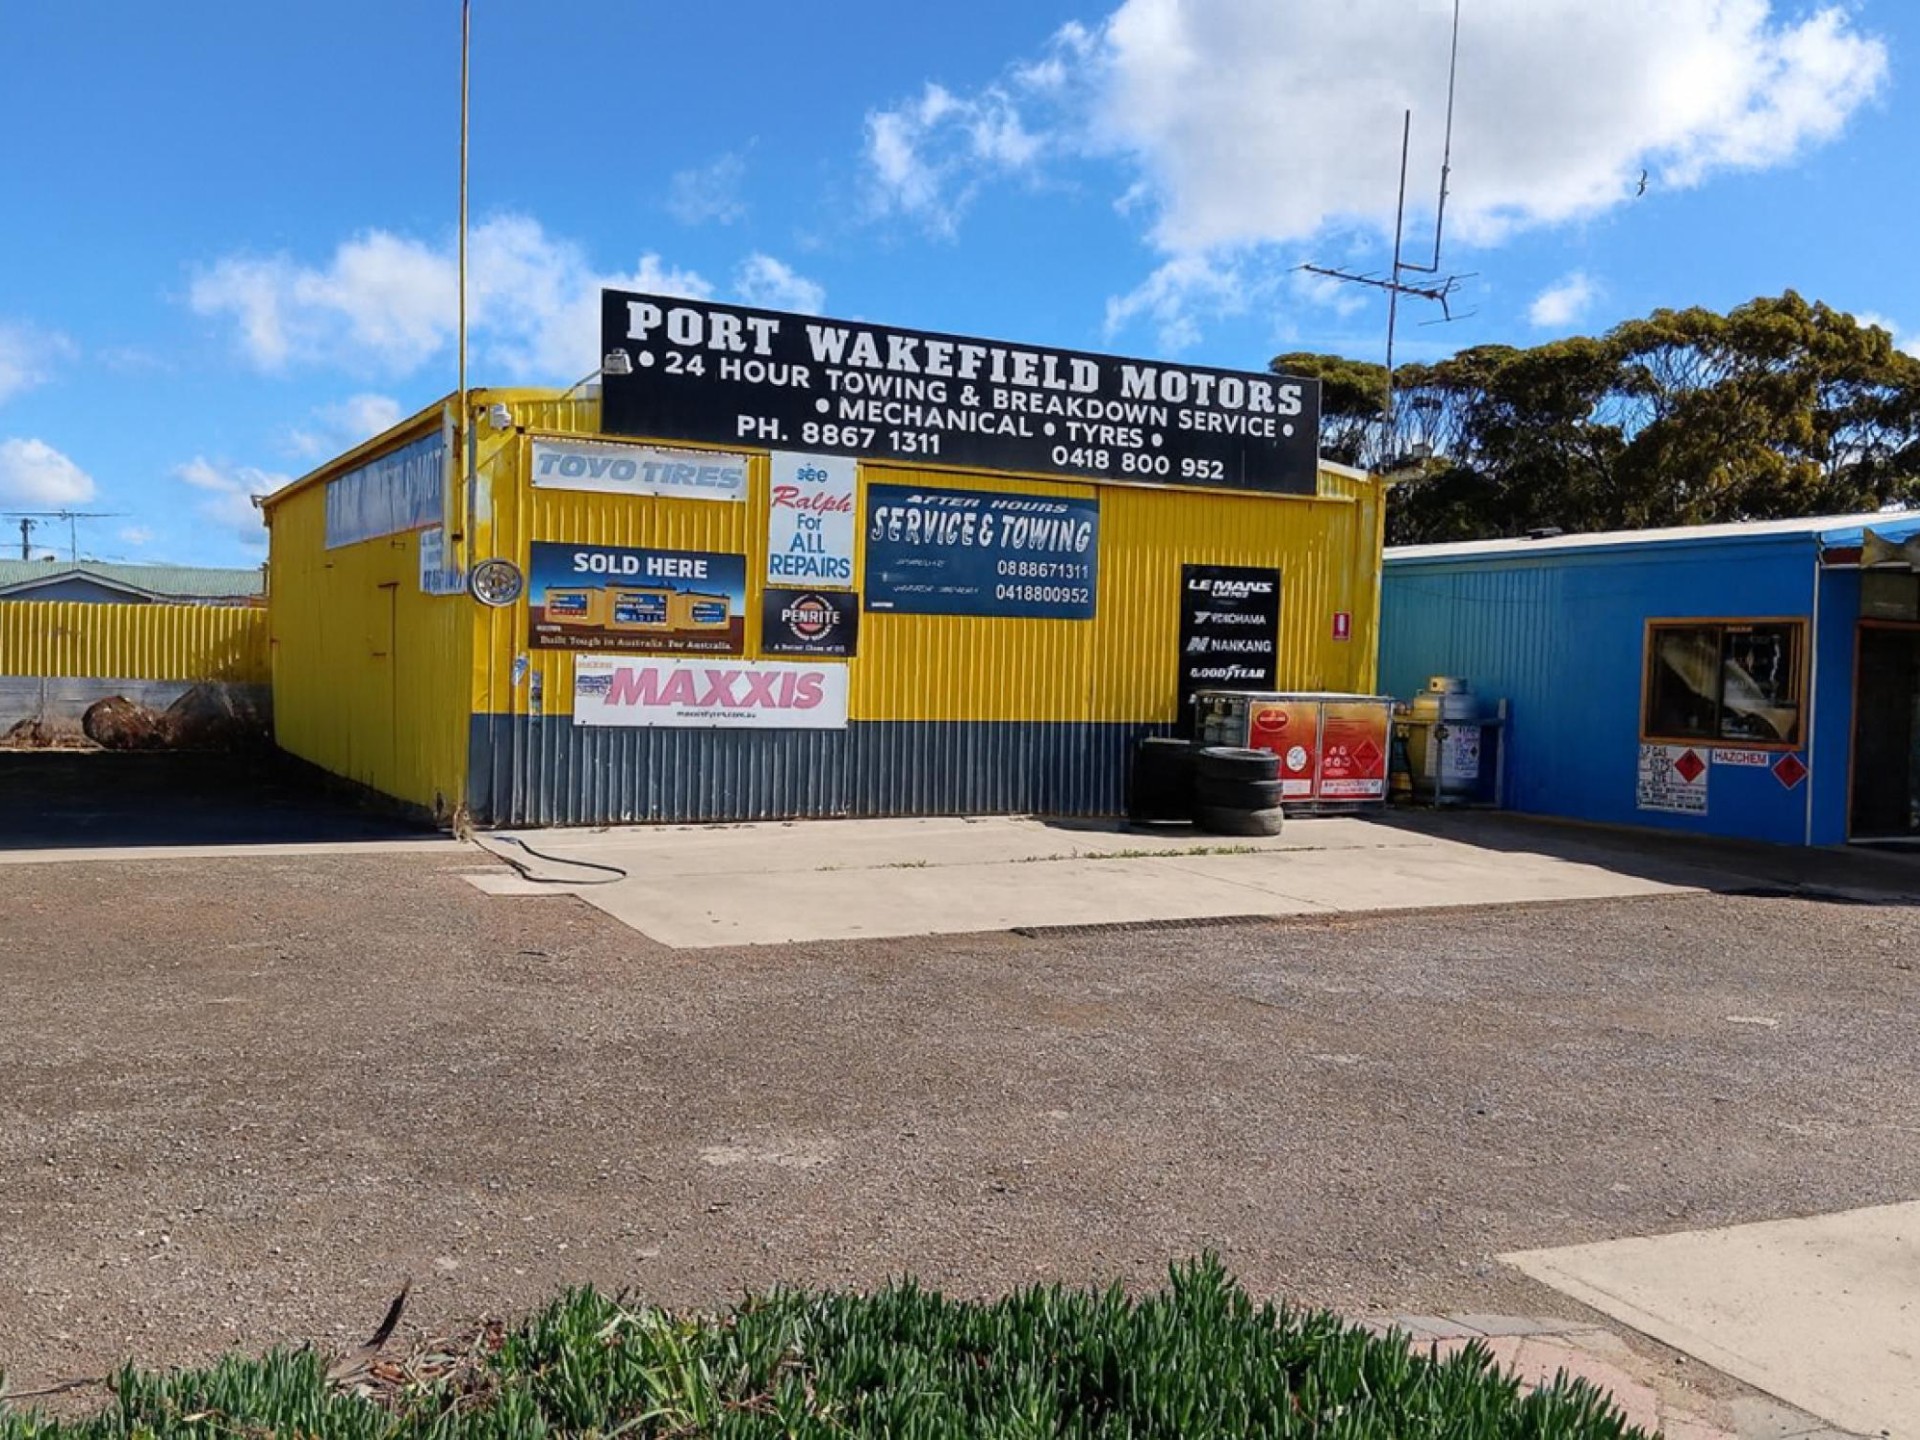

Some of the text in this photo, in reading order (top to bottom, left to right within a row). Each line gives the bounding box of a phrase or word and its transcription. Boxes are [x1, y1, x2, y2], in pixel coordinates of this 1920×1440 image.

[627, 301, 1302, 415] PORT WAKEFIELD MOTORS
[665, 351, 1275, 438] 24 HOUR TOWING & BREAKDOWN SERVICE
[737, 415, 940, 455] PH. 8867 1311
[839, 400, 1144, 448] MECHANICAL TYRES
[642, 460, 743, 489] TIRES
[1052, 446, 1224, 481] 0418 800 952
[797, 467, 828, 484] see
[771, 485, 852, 515] Ralph
[907, 494, 1069, 514] AFTER HOURS
[797, 514, 822, 532] For
[871, 506, 1092, 552] SERVICE & TOWING
[790, 532, 825, 554] ALL
[574, 552, 708, 579] SOLD HERE
[770, 554, 851, 579] REPAIRS
[997, 560, 1089, 579] 0888671311
[995, 585, 1089, 604] 0418800952
[1188, 579, 1273, 592] LE MANS
[782, 609, 841, 624] PENRITE
[540, 635, 567, 645] Built
[570, 636, 600, 647] Tough
[1211, 639, 1272, 652] NANKANG
[1190, 664, 1266, 680] GOODYEAR
[603, 667, 824, 710] MAXXIS
[1714, 750, 1767, 764] HAZCHEM
